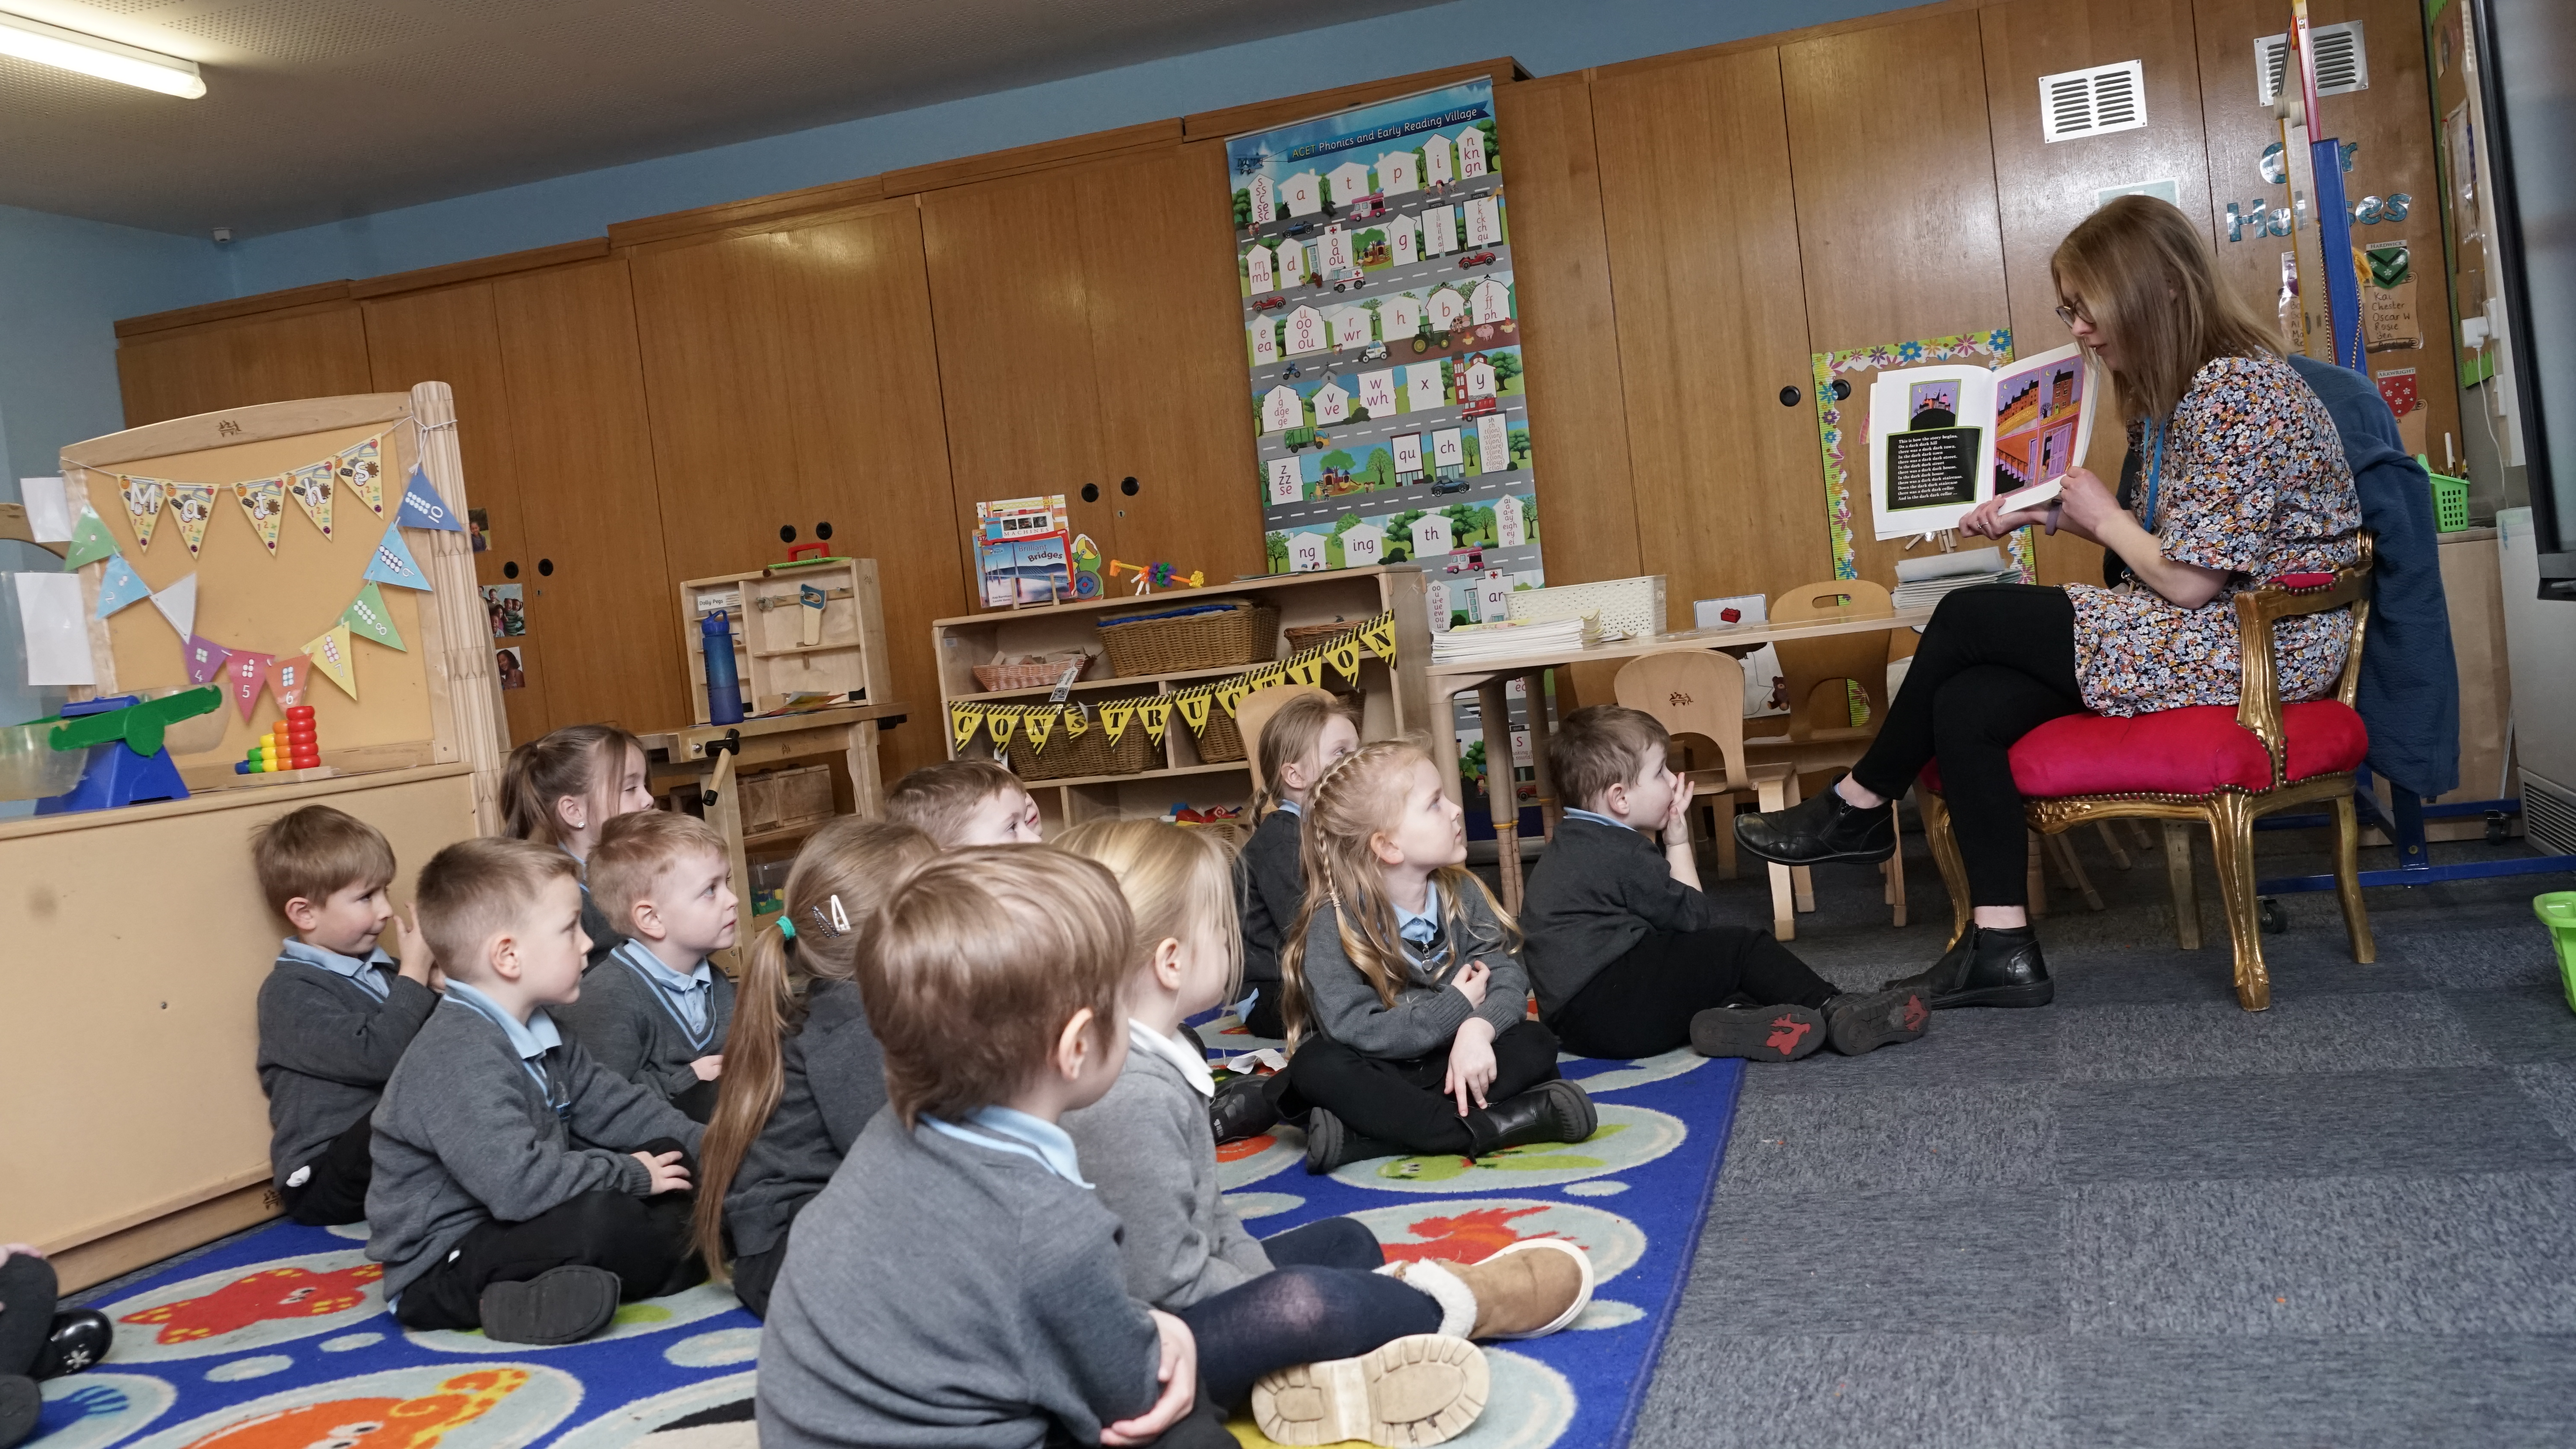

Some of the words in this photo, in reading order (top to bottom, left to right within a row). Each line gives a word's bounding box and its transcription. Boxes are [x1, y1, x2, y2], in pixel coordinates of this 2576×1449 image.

[1292, 145, 1316, 158] ACET
[1319, 138, 1354, 152] Phonics
[1357, 133, 1374, 143] and
[1378, 126, 1400, 139] Early
[1405, 117, 1441, 131] Reading
[1445, 109, 1476, 122] Village
[1467, 137, 1475, 146] n
[1464, 148, 1480, 160] kn
[1437, 155, 1441, 168] i
[2260, 142, 2358, 184] Or
[1465, 162, 1482, 177] gn
[1394, 168, 1402, 183] p
[1258, 178, 1263, 186] s
[1346, 177, 1352, 189] t
[1256, 186, 1266, 196] ss
[1297, 190, 1306, 200] a
[1260, 195, 1265, 203] c
[1258, 203, 1268, 213] se
[1258, 212, 1269, 221] sc
[1477, 214, 1485, 223] ck
[2227, 193, 2412, 243] Hoes
[1477, 223, 1487, 232] ch
[1331, 238, 1338, 246] o
[1399, 235, 1407, 250] g
[1478, 233, 1488, 243] qu
[1332, 247, 1340, 255] a
[1255, 261, 1264, 270] m
[1287, 256, 1296, 271] d
[1329, 256, 1345, 266] ou
[1252, 272, 1270, 283] mb
[1300, 309, 1307, 318] u
[1442, 302, 1450, 317] b
[1349, 318, 1354, 327] r
[1397, 310, 1406, 324] h
[1484, 310, 1497, 324] ph
[2372, 313, 2399, 322] Oscar
[1297, 319, 1312, 329] oo
[1261, 330, 1266, 338] e
[1302, 330, 1309, 338] o
[1344, 330, 1361, 341] wr
[1258, 342, 1272, 352] ea
[1298, 339, 1315, 349] ou
[1370, 379, 1382, 389] w
[1422, 379, 1429, 391] x
[1476, 374, 1484, 389] y
[1279, 399, 1283, 408] g
[1327, 393, 1334, 403] v
[1367, 391, 1389, 406] wh
[1275, 407, 1289, 418] dge
[1325, 405, 1339, 415] ve
[1278, 418, 1287, 428] ge
[1440, 440, 1455, 453] ch
[1400, 449, 1416, 463] qu
[1281, 466, 1287, 474] z
[1279, 475, 1291, 485] zz
[1280, 485, 1292, 495] se
[428, 506, 443, 523] 10
[1004, 528, 1049, 536] MACHINES
[1503, 521, 1517, 532] eigh
[1425, 526, 1439, 540] th
[1353, 539, 1374, 553] ing
[1028, 551, 1063, 562] Bridges
[1300, 547, 1315, 561] ng
[402, 567, 414, 577] 9
[106, 591, 115, 604] 2
[376, 622, 387, 636] 8
[195, 670, 203, 682] 4
[334, 664, 344, 677] 7
[242, 685, 250, 698] 5
[286, 691, 294, 704] 6
